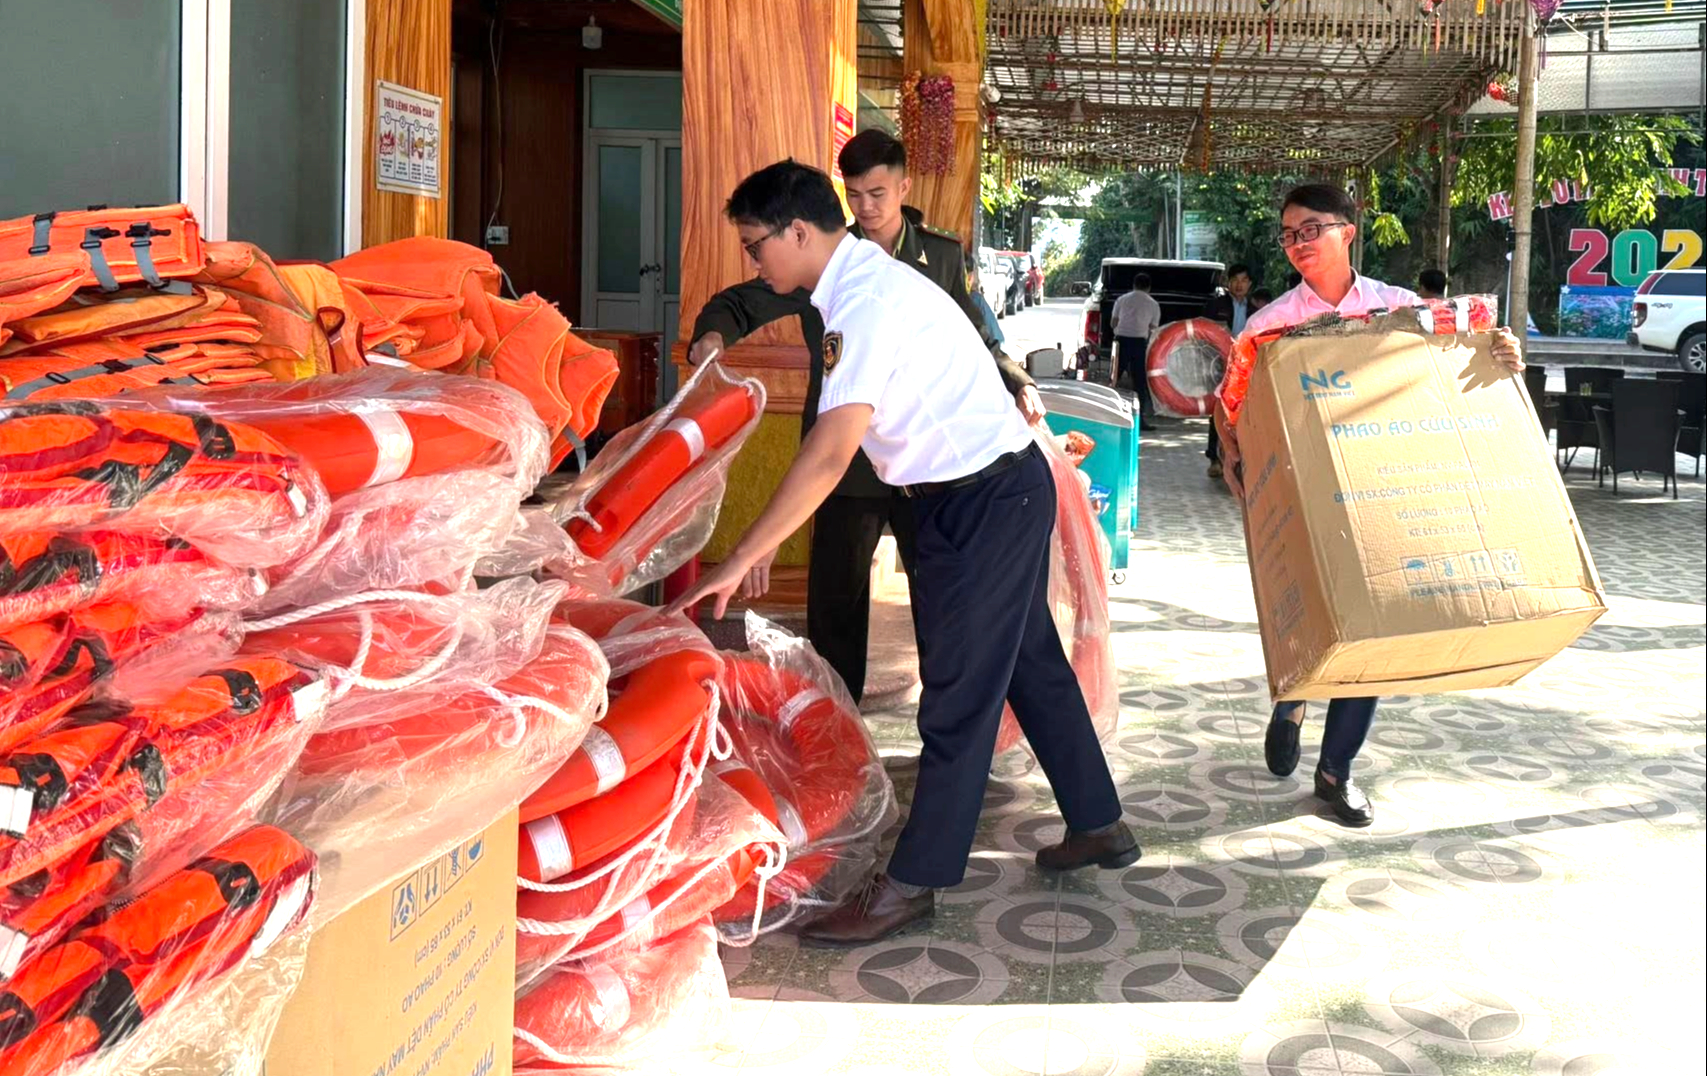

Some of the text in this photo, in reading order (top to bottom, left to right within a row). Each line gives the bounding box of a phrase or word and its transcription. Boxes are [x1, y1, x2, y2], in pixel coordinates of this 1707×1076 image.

[1299, 368, 1351, 392] NG
[1331, 422, 1381, 438] PHAO
[1407, 484, 1417, 494] TY
[414, 969, 434, 1001] PHAO
[455, 979, 462, 1001] TY
